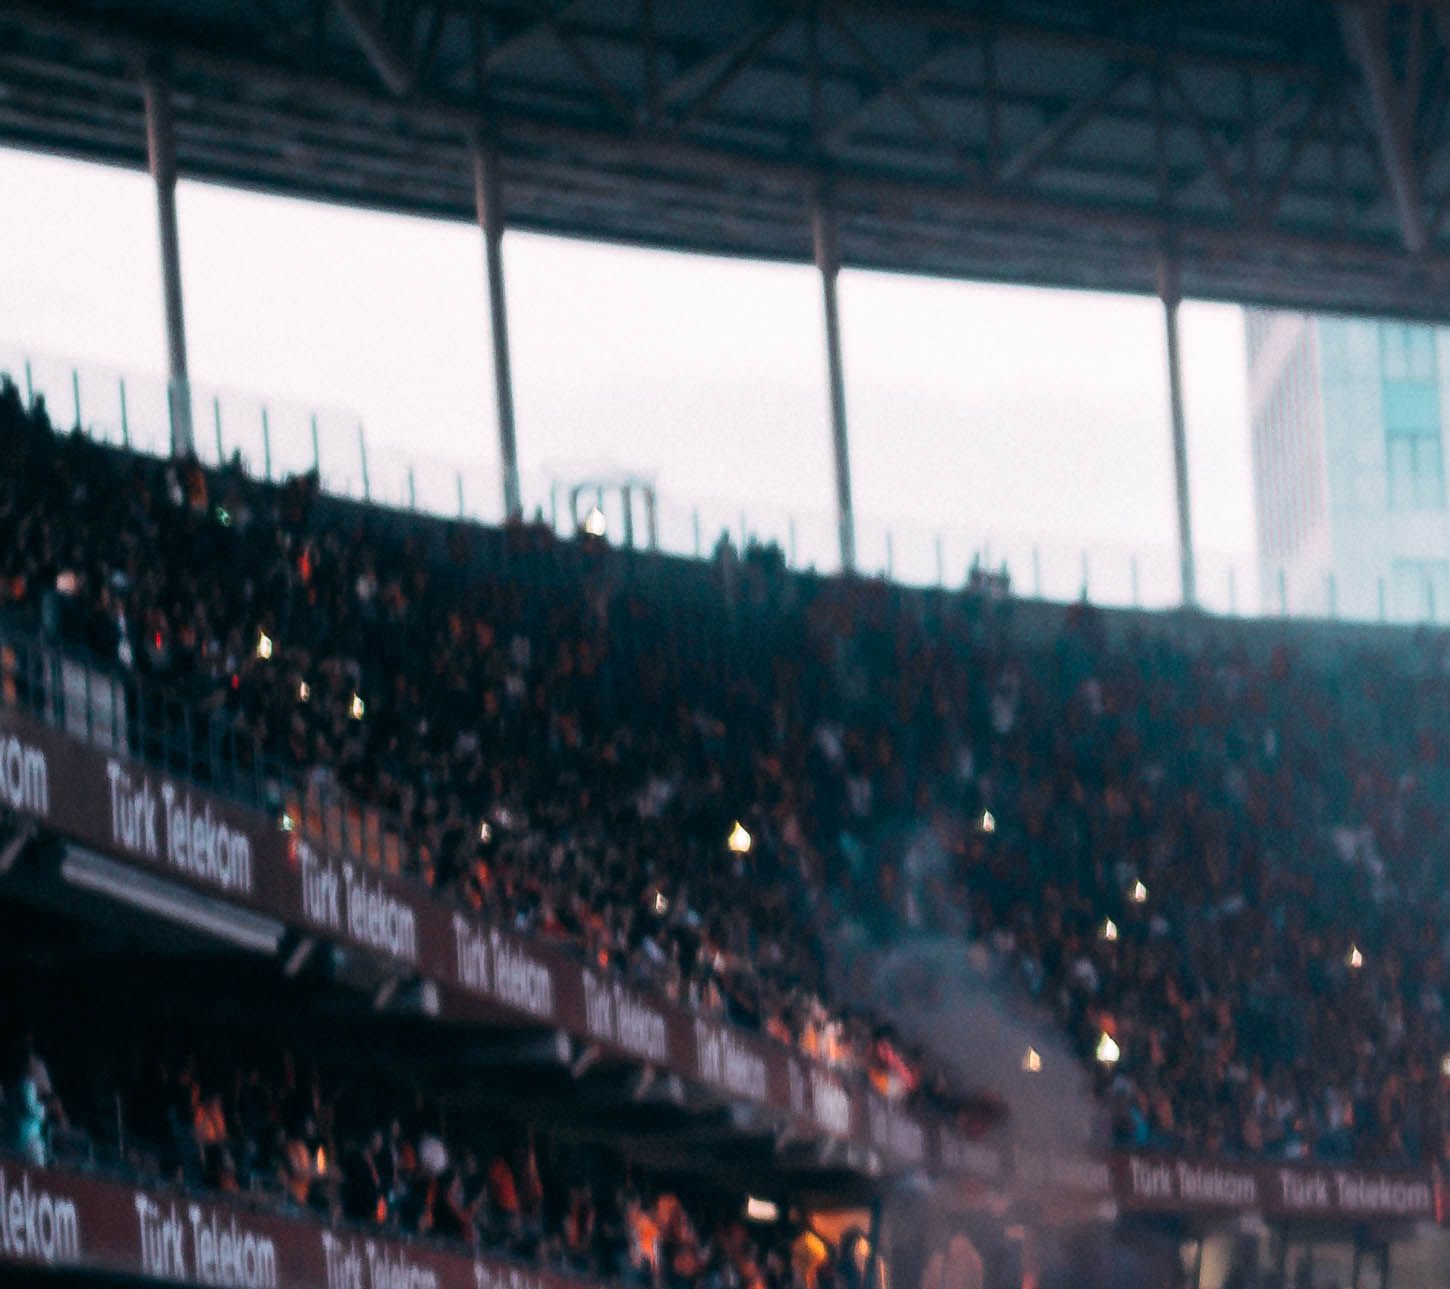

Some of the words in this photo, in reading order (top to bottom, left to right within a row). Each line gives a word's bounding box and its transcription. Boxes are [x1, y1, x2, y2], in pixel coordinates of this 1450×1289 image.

[107, 757, 157, 858] Türk
[161, 779, 251, 893] Telekom
[134, 1189, 185, 1283] Türk
[1279, 1168, 1330, 1209] Türk
[1335, 1171, 1430, 1213] Telekom
